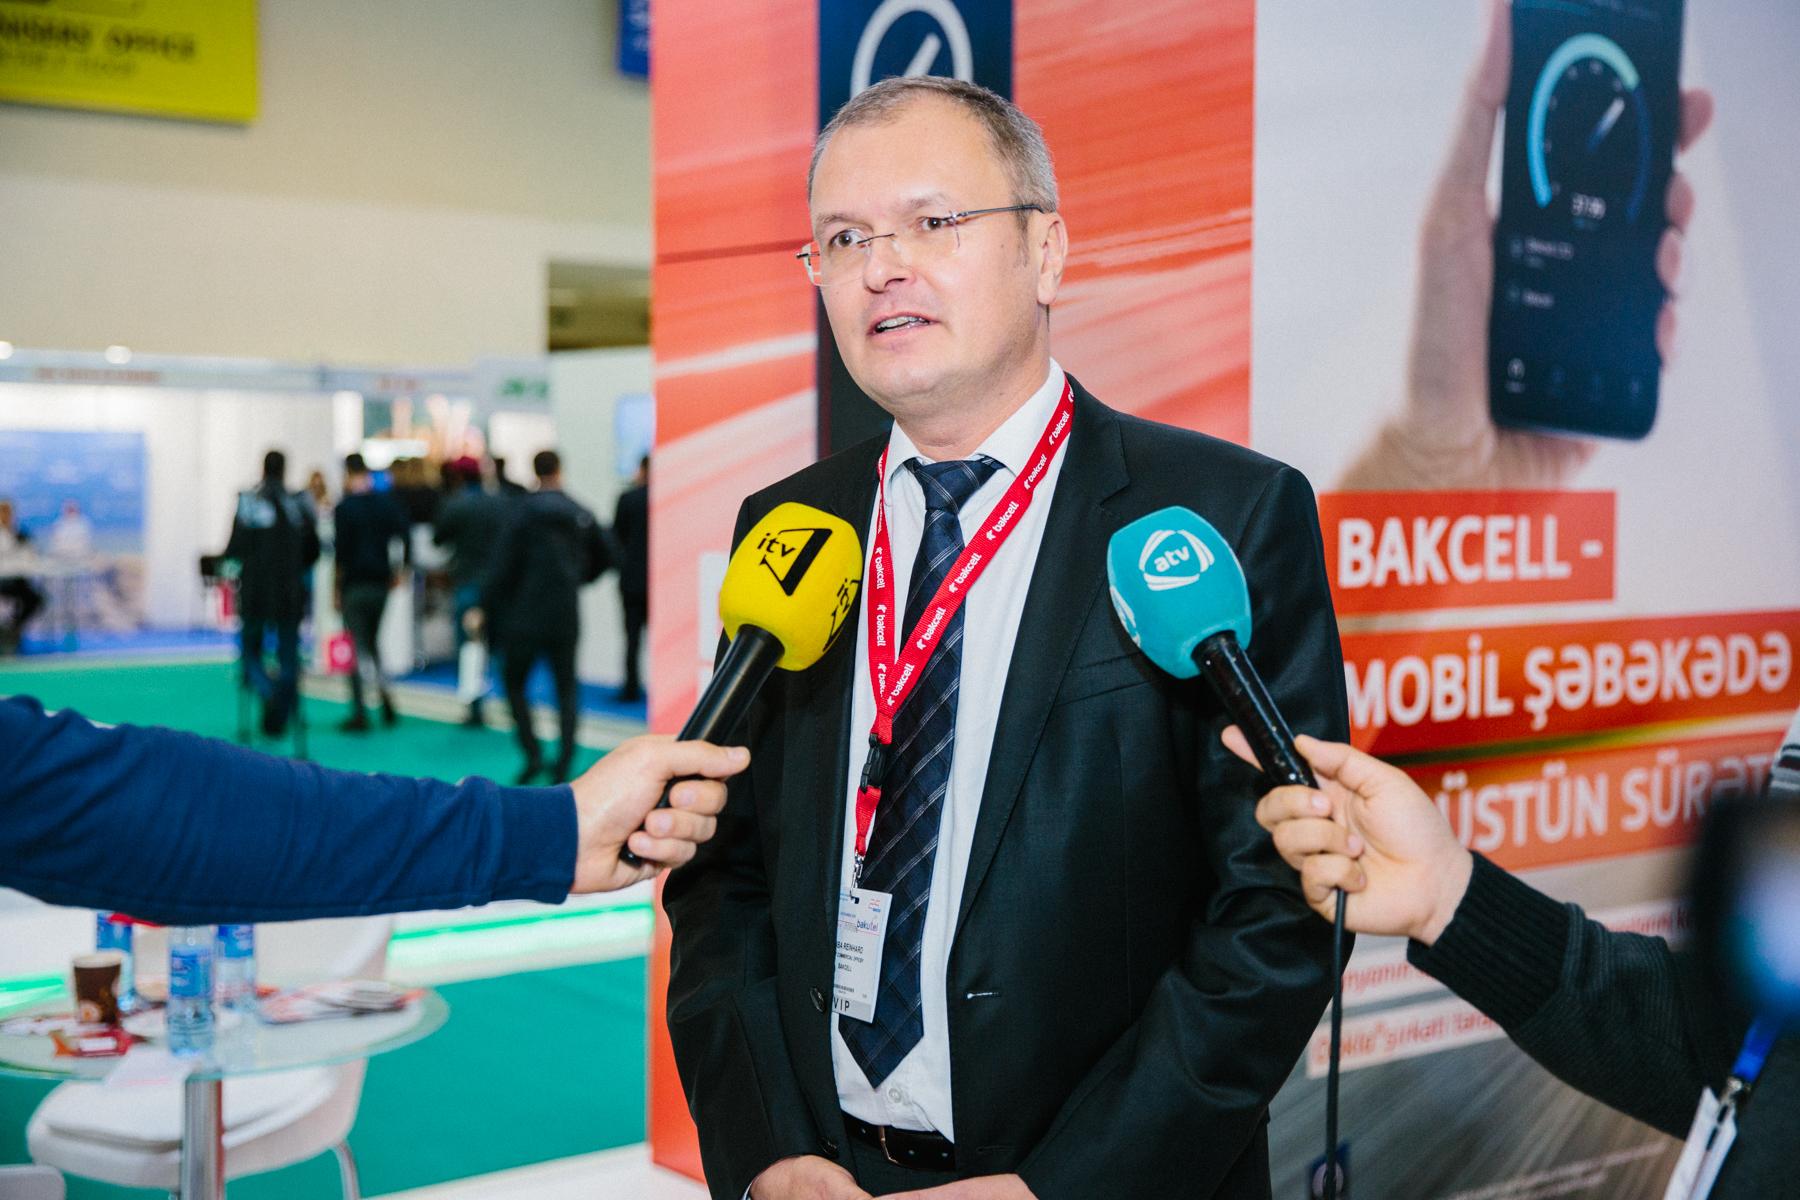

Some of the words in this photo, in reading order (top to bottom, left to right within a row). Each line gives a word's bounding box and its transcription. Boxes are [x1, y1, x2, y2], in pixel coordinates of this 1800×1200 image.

[1052, 411, 1070, 439] bakcell
[1027, 453, 1048, 483] bakcell
[992, 501, 1020, 532] bakcell
[757, 532, 796, 557] itv
[1154, 546, 1190, 572] atv
[1338, 515, 1571, 588] BAKCELL
[874, 556, 886, 589] bakcell
[955, 552, 982, 584] bakcell
[876, 615, 887, 647] bakcell
[922, 606, 947, 641] bakcell
[891, 663, 915, 696] bakcell
[1343, 635, 1514, 730] MOBİL
[1523, 631, 1791, 731] ŞƏBƏKƏDƏ
[1435, 760, 1609, 850] ÜSTÜN
[833, 996, 850, 1012] VIP
